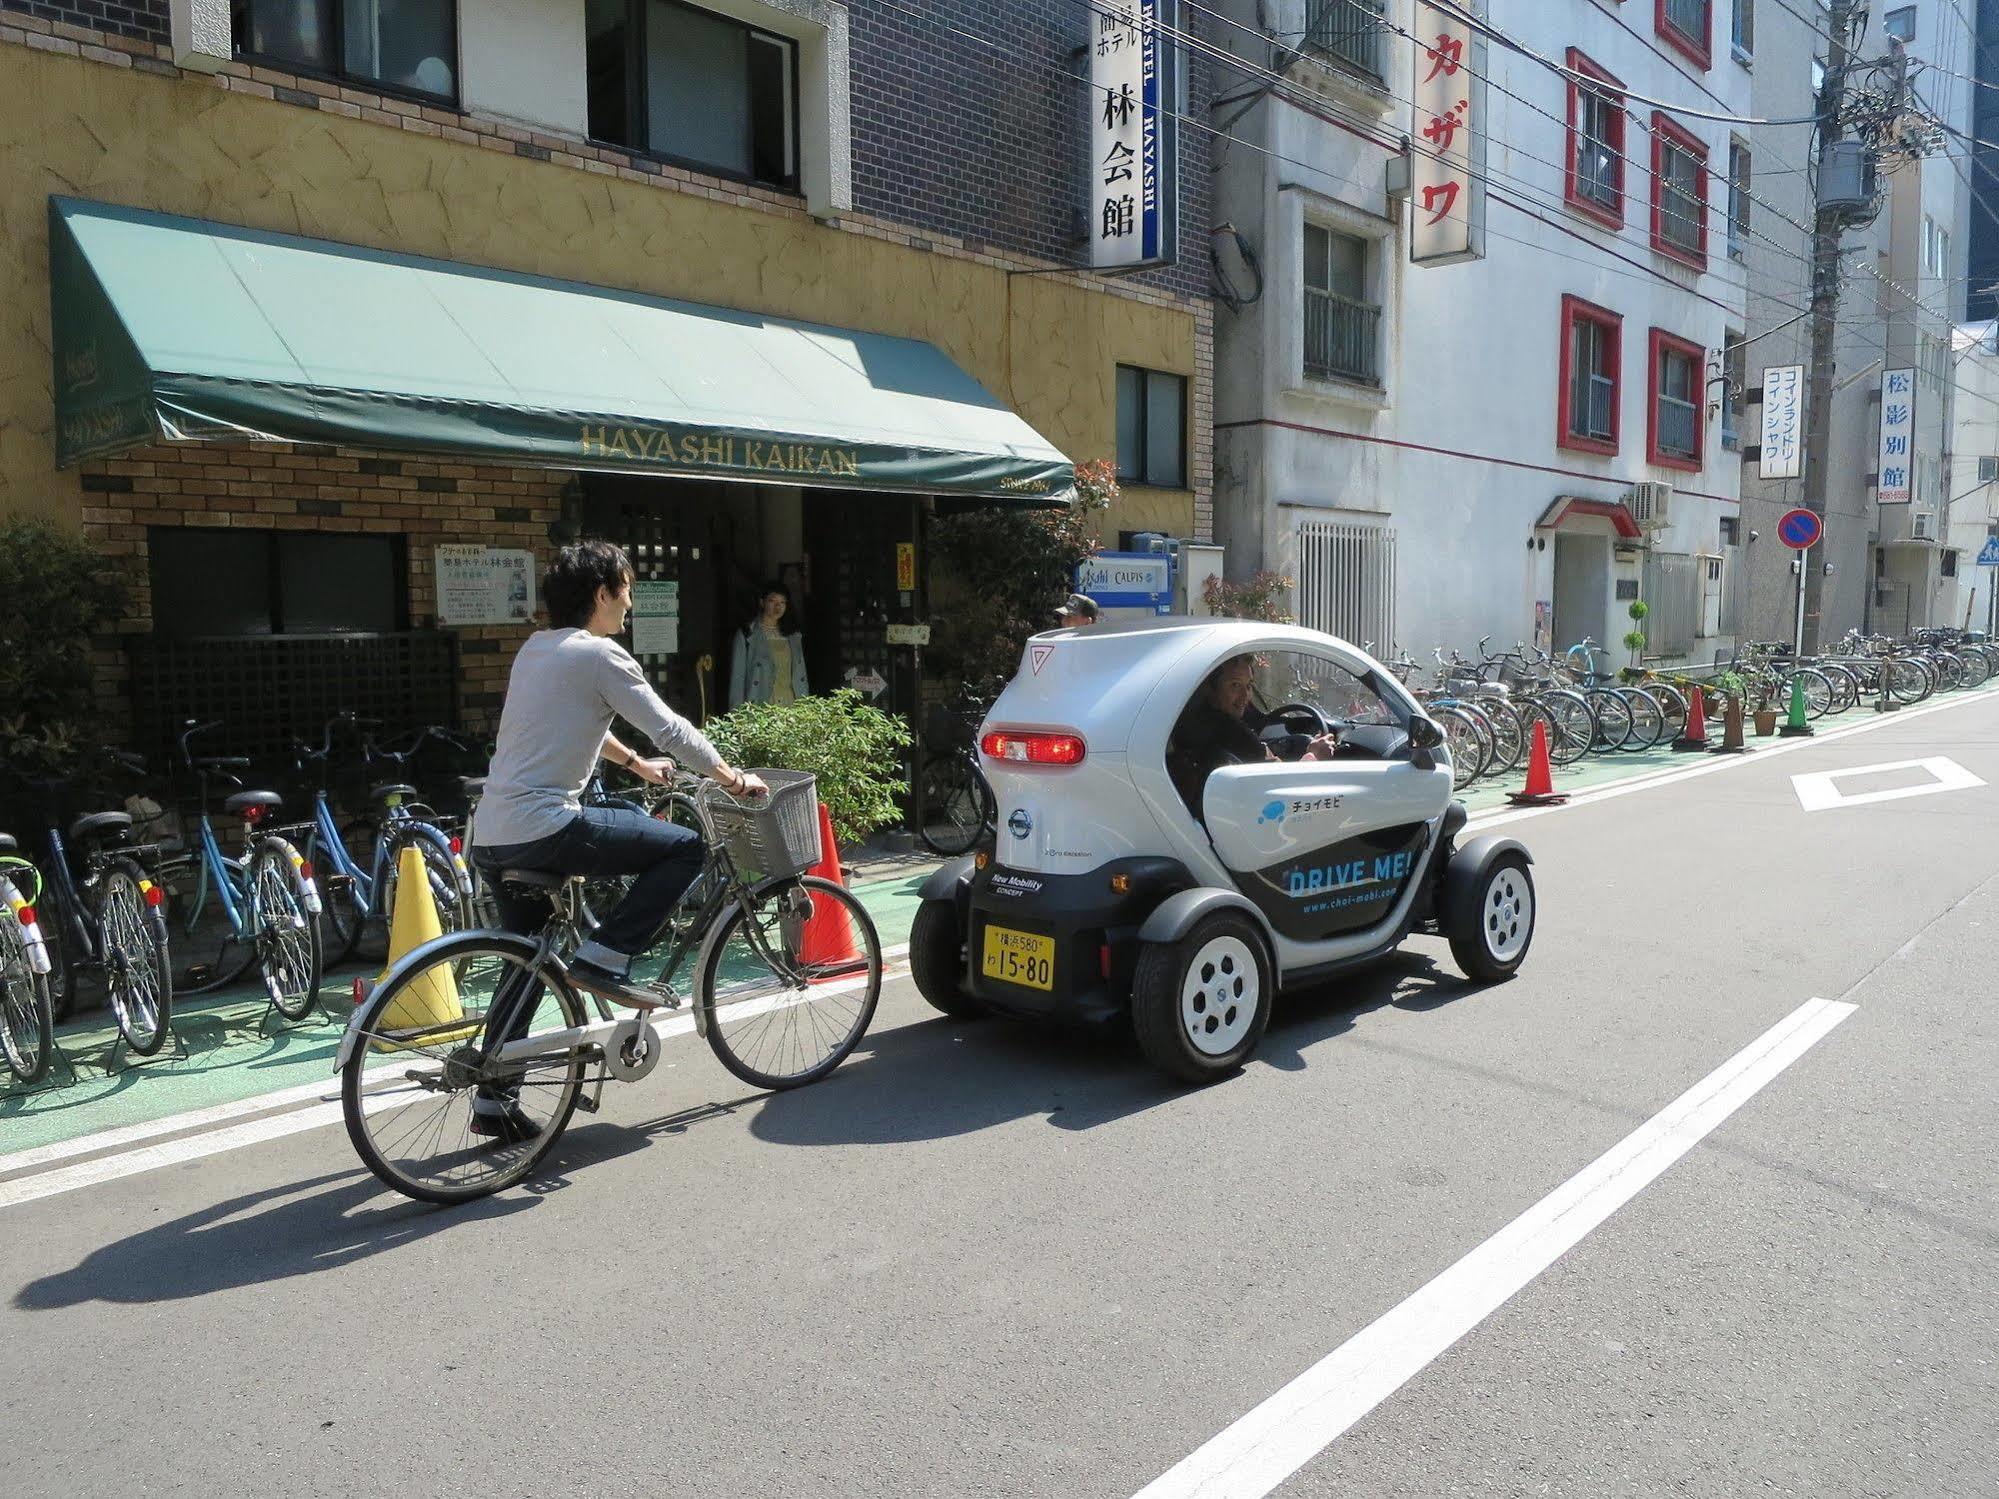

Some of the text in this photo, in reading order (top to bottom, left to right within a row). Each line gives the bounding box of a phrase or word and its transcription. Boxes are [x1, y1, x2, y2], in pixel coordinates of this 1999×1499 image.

[1097, 27, 1137, 57] ホテル
[1422, 2, 1469, 227] カザワ
[1101, 83, 1136, 240] 林会館
[1143, 115, 1156, 212] HAYASHI
[1766, 372, 1780, 474] コインシャワー
[1782, 370, 1797, 477] コインランドリー
[1884, 374, 1909, 488] 松影別館
[581, 424, 859, 477] HAYASHI KAIKAN
[1114, 571, 1144, 585] CALPIS
[1292, 794, 1345, 813] チョイモビ
[992, 874, 1043, 891] New Mobility
[996, 886, 1024, 897] CONCEPT
[1289, 851, 1412, 897] DRIVE ME!
[1303, 887, 1397, 913] www.choi-mobi.com
[1000, 949, 1050, 985] 15-80
